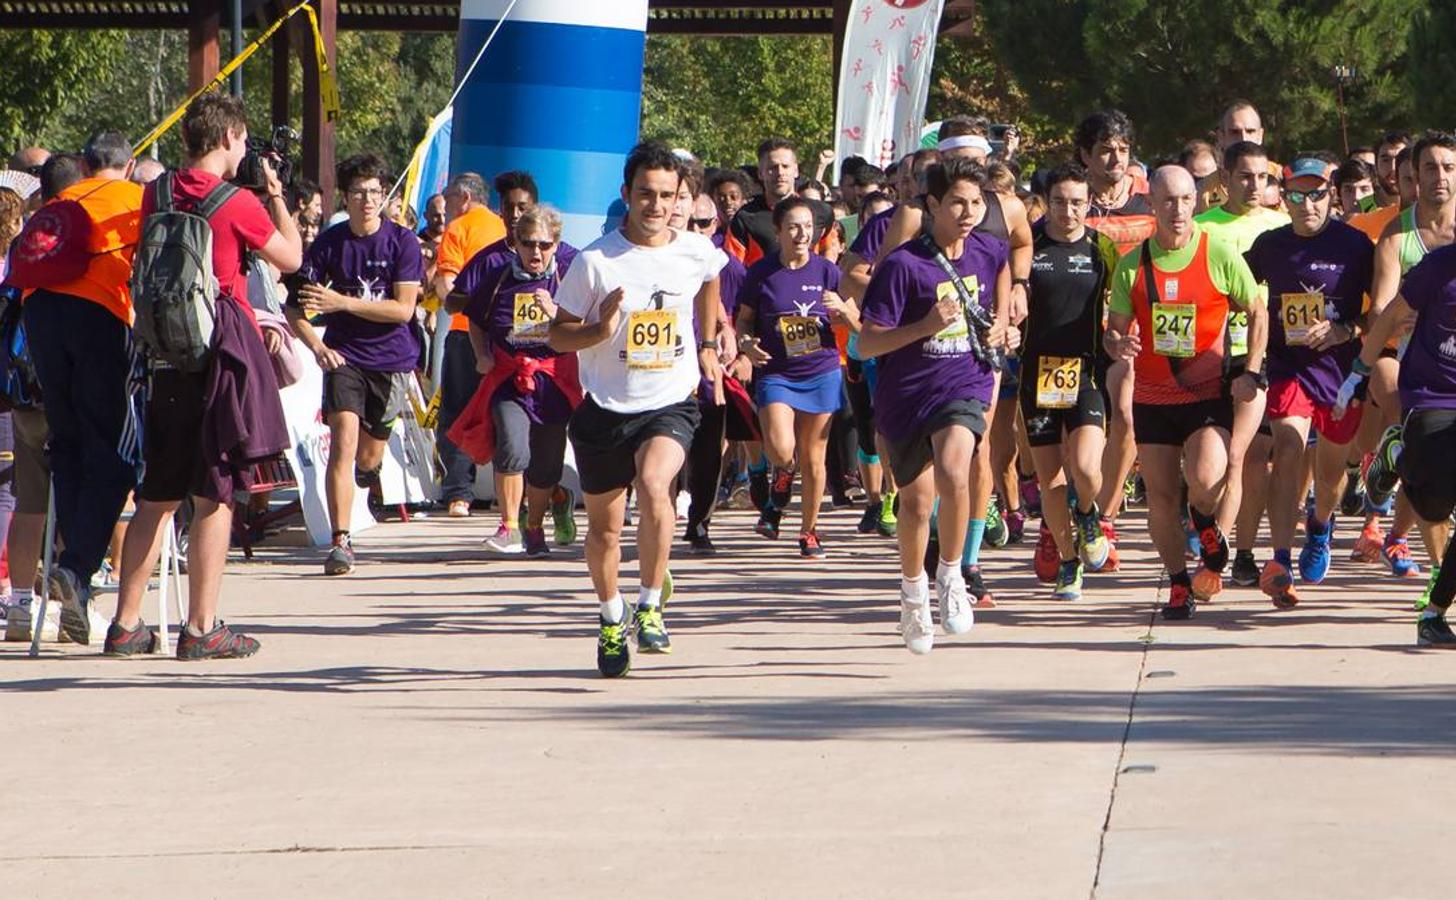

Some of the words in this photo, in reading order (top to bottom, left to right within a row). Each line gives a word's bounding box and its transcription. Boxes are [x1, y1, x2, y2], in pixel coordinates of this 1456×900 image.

[1156, 314, 1193, 336] 247
[1286, 304, 1320, 325] 611
[633, 322, 671, 346] 691
[786, 321, 816, 341] 896
[1042, 368, 1077, 389] 763
